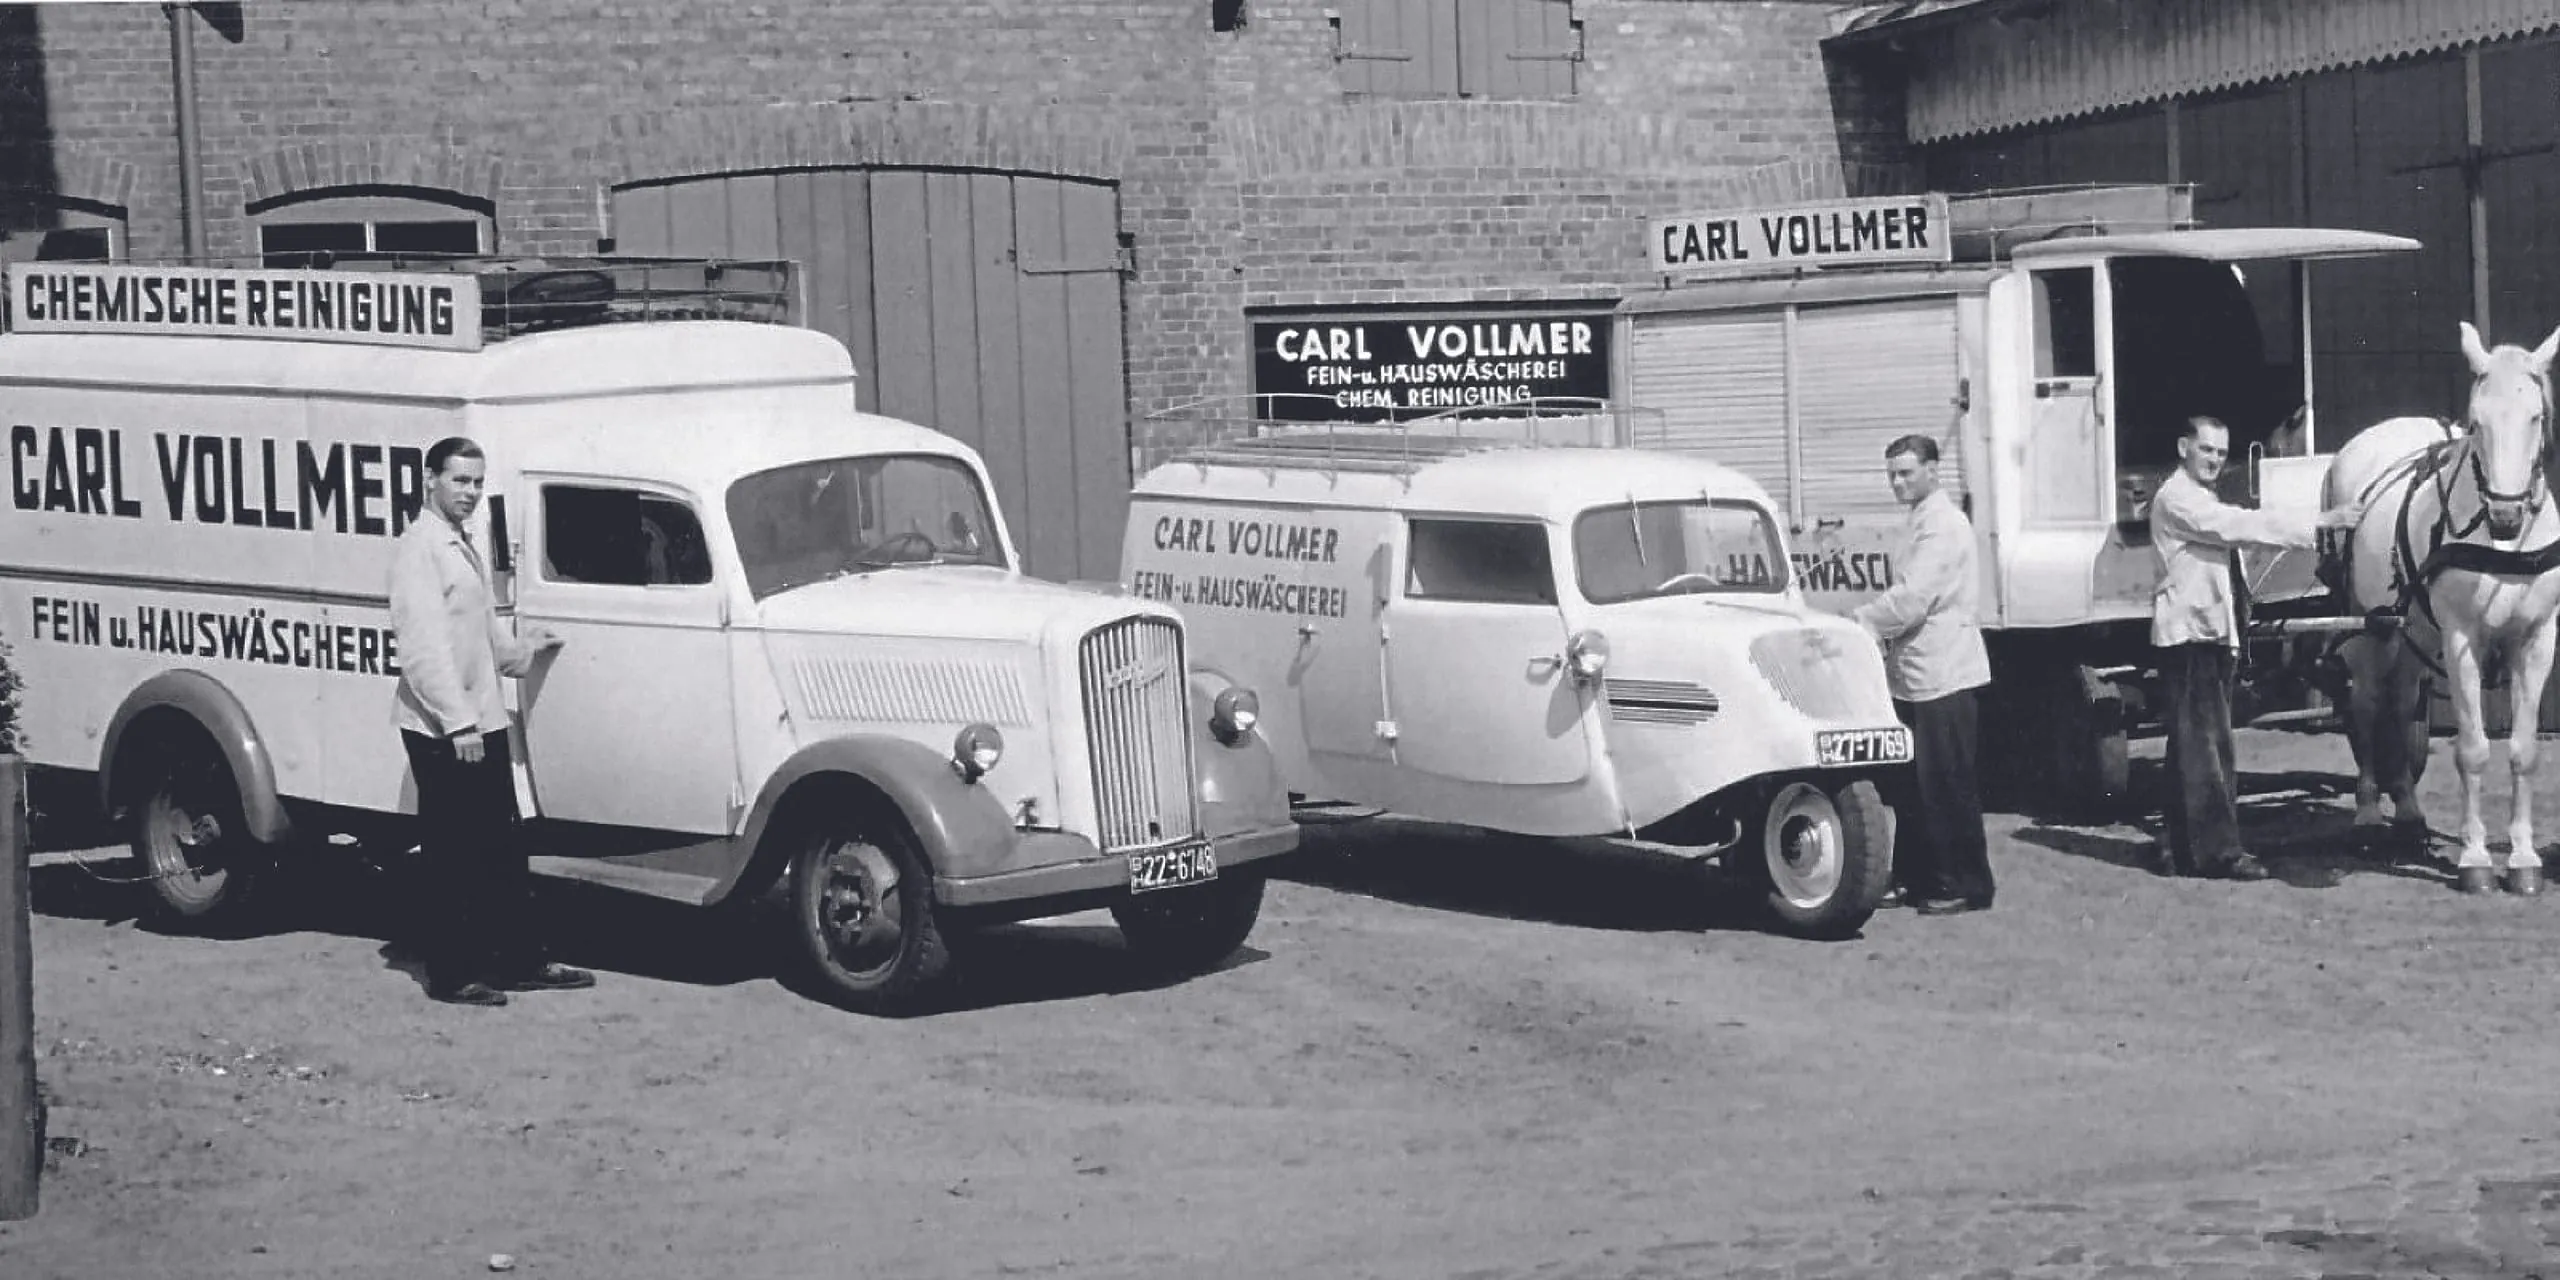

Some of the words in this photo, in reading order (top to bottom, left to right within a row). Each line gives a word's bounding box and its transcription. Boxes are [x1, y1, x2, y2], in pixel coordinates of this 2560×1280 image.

[1663, 219, 1748, 263] CARL
[1760, 206, 1928, 257] VOLLMER
[25, 273, 236, 326] CHEMISCHE
[247, 279, 453, 335] REINIGUNG
[1276, 326, 1372, 362] CARL
[1406, 322, 1592, 358] VOLLMER
[1336, 388, 1398, 408] CHEM.
[1407, 385, 1531, 407] REINIGUNG
[11, 425, 141, 518] CARL
[154, 432, 424, 537] VOLLMER
[1154, 516, 1215, 553] CARL
[1228, 520, 1339, 562] VOLLMER
[32, 596, 100, 646] FEIN
